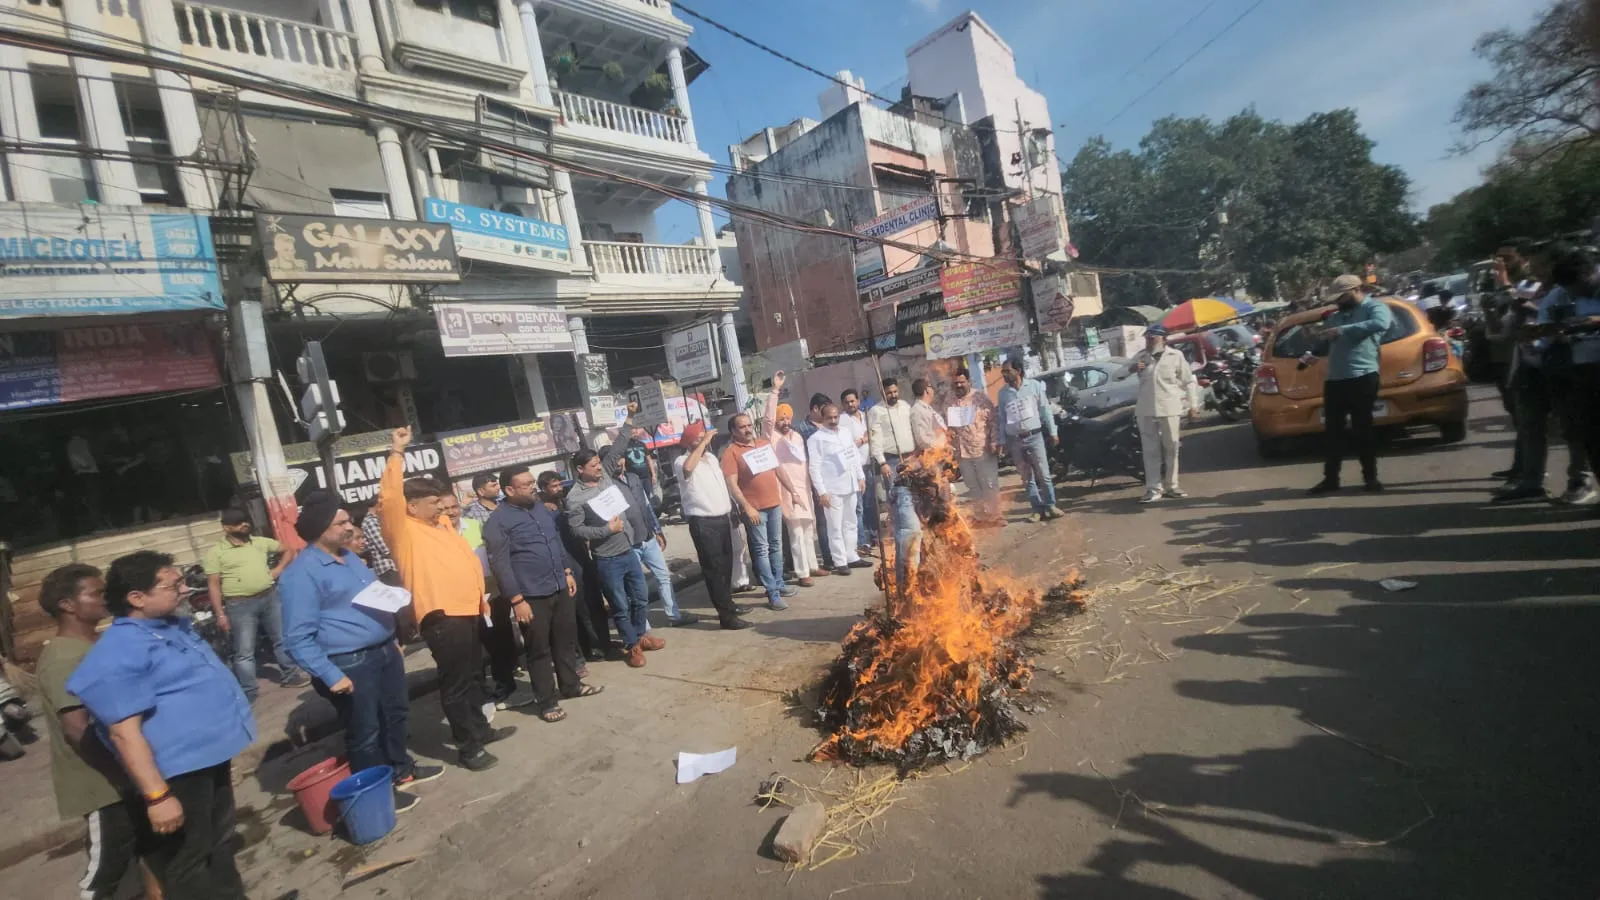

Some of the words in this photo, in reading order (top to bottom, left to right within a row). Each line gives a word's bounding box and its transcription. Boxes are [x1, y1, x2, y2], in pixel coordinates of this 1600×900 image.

[430, 202, 472, 224] U.S.
[478, 211, 567, 243] SYSTEMS
[879, 214, 907, 234] DENTAL
[908, 204, 936, 222] CLINIC
[0, 236, 143, 260] MICROTEK
[302, 222, 447, 252] GALAXY
[383, 252, 452, 272] Saloon
[0, 297, 122, 310] ELECTRICALS
[471, 312, 513, 325] BOON
[515, 311, 565, 325] DENTAL
[518, 324, 541, 334] care
[63, 325, 147, 348] INDIA
[315, 448, 440, 490] IAMND
